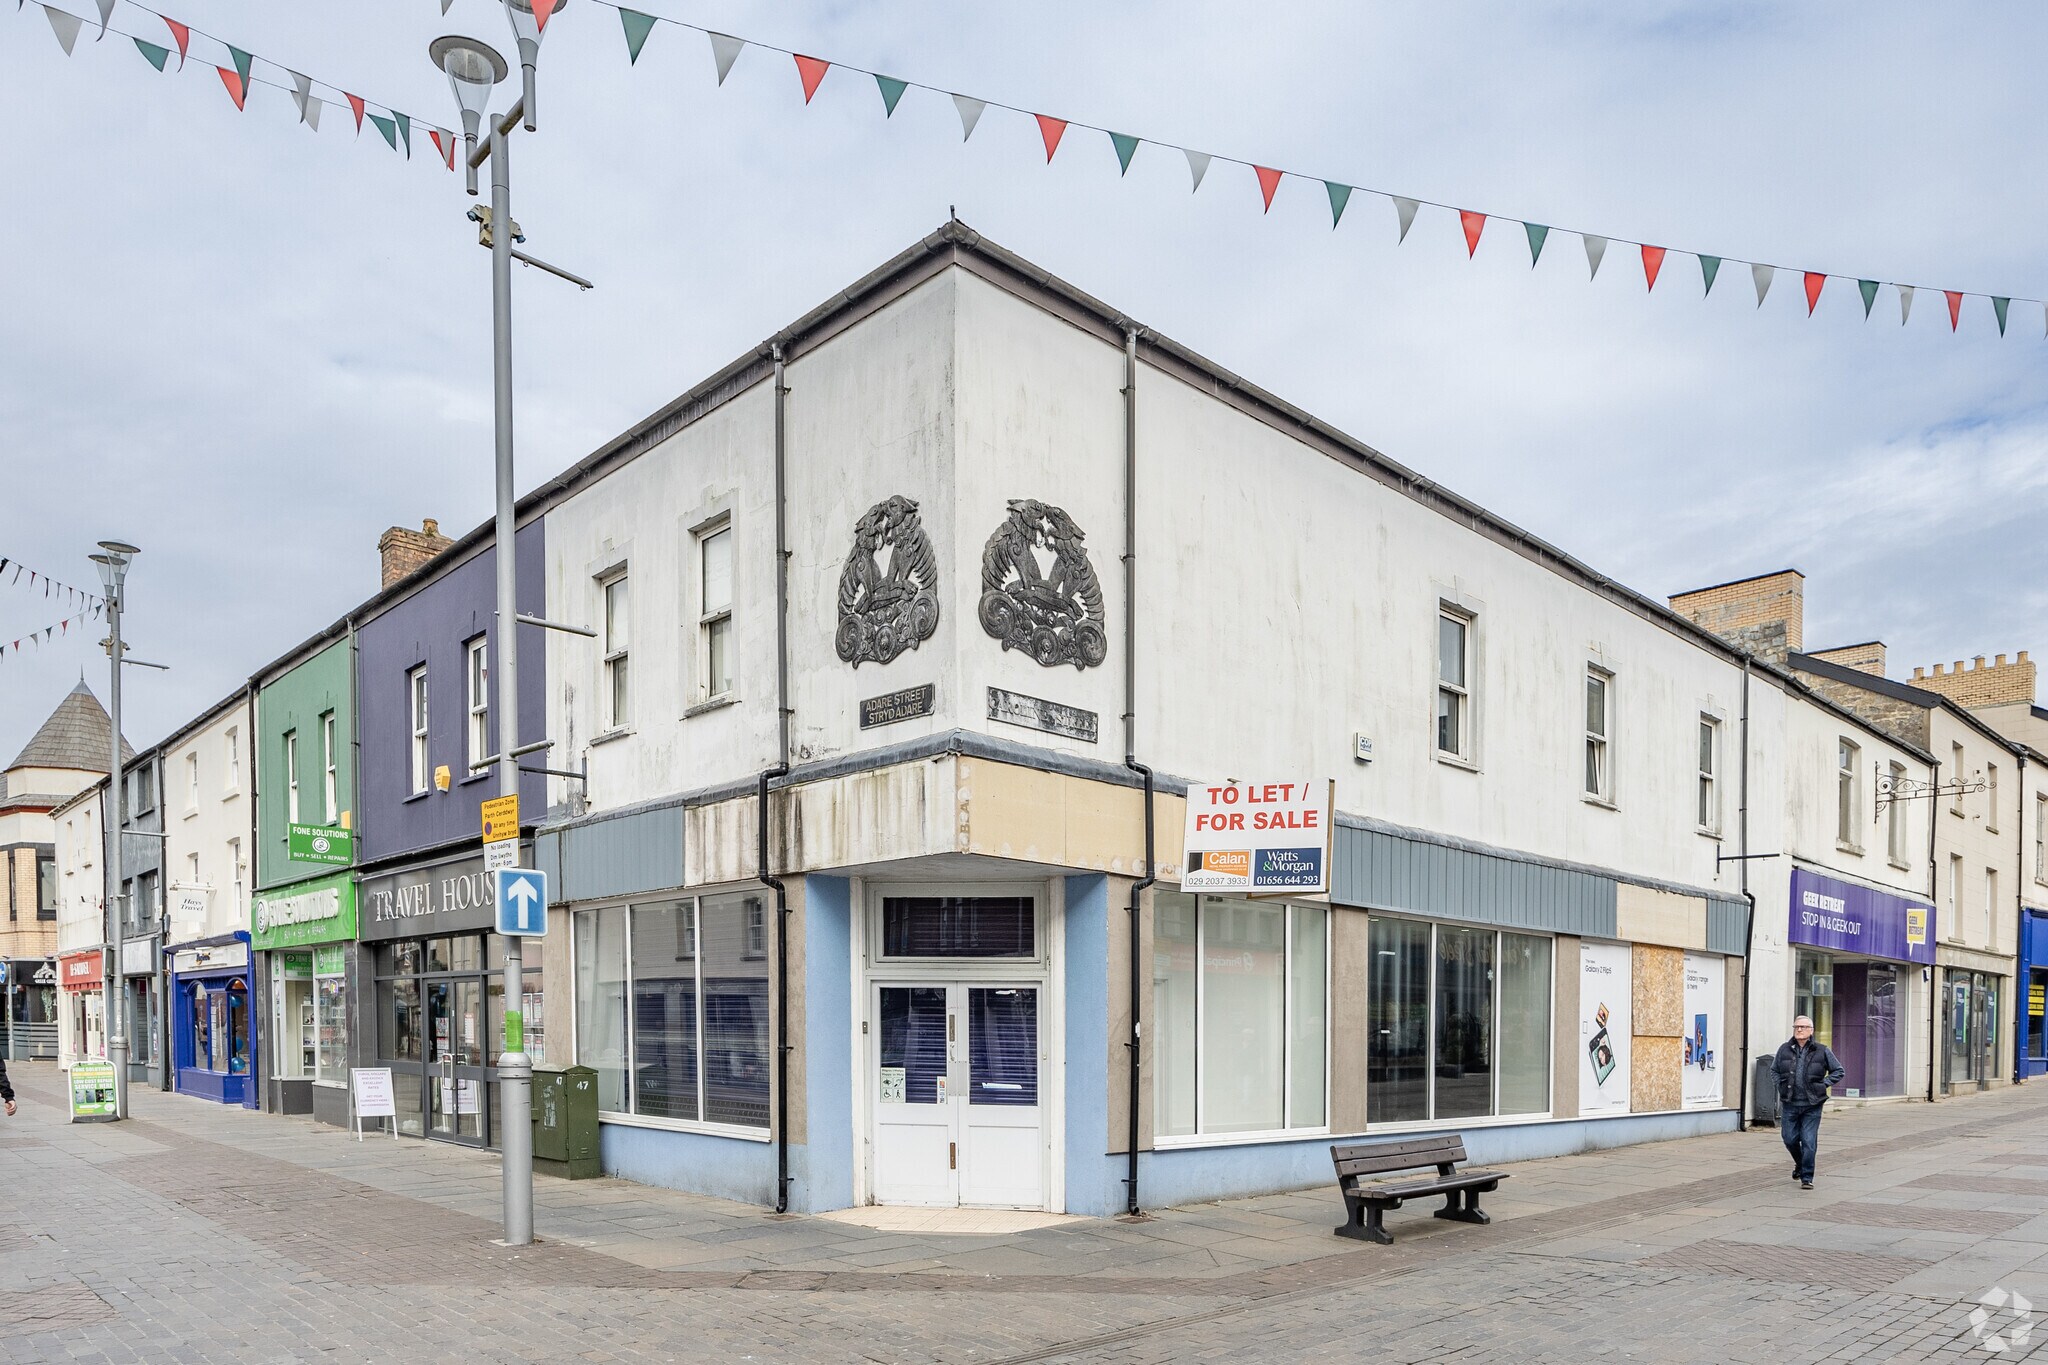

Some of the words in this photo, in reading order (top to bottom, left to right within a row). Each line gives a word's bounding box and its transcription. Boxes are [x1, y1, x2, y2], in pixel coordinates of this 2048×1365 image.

[866, 695, 892, 712] ADARE
[894, 687, 926, 705] STREET
[869, 708, 894, 724] STRYD
[895, 702, 923, 718] ADARE
[1207, 786, 1239, 805] TO
[1248, 783, 1294, 803] LET
[1302, 782, 1309, 801] /
[484, 801, 504, 810] Pedestrian
[496, 809, 515, 817] Cerddwyr
[1196, 813, 1245, 831] FOR
[1253, 810, 1318, 830] SALE
[292, 826, 311, 836] FONE
[312, 829, 349, 839] SOLUTIONS
[497, 842, 511, 850] loading
[1267, 851, 1299, 862] Watts
[1262, 861, 1314, 874] &Morgan
[1256, 876, 1283, 884] 01656
[1284, 876, 1300, 884] 644
[1302, 876, 1318, 884] 293
[373, 883, 436, 922] TRAVEL
[441, 871, 496, 912] HOUS
[1803, 890, 1819, 908] GEEK
[1819, 894, 1845, 914] RETREAT
[1802, 911, 1819, 927] STOP
[1820, 914, 1826, 928] IN
[1826, 916, 1832, 930] &
[1832, 918, 1848, 933] GEEK
[1848, 921, 1862, 935] OUT
[1585, 965, 1600, 974] Galaxy
[556, 1076, 563, 1086] 47
[577, 1081, 588, 1090] 47
